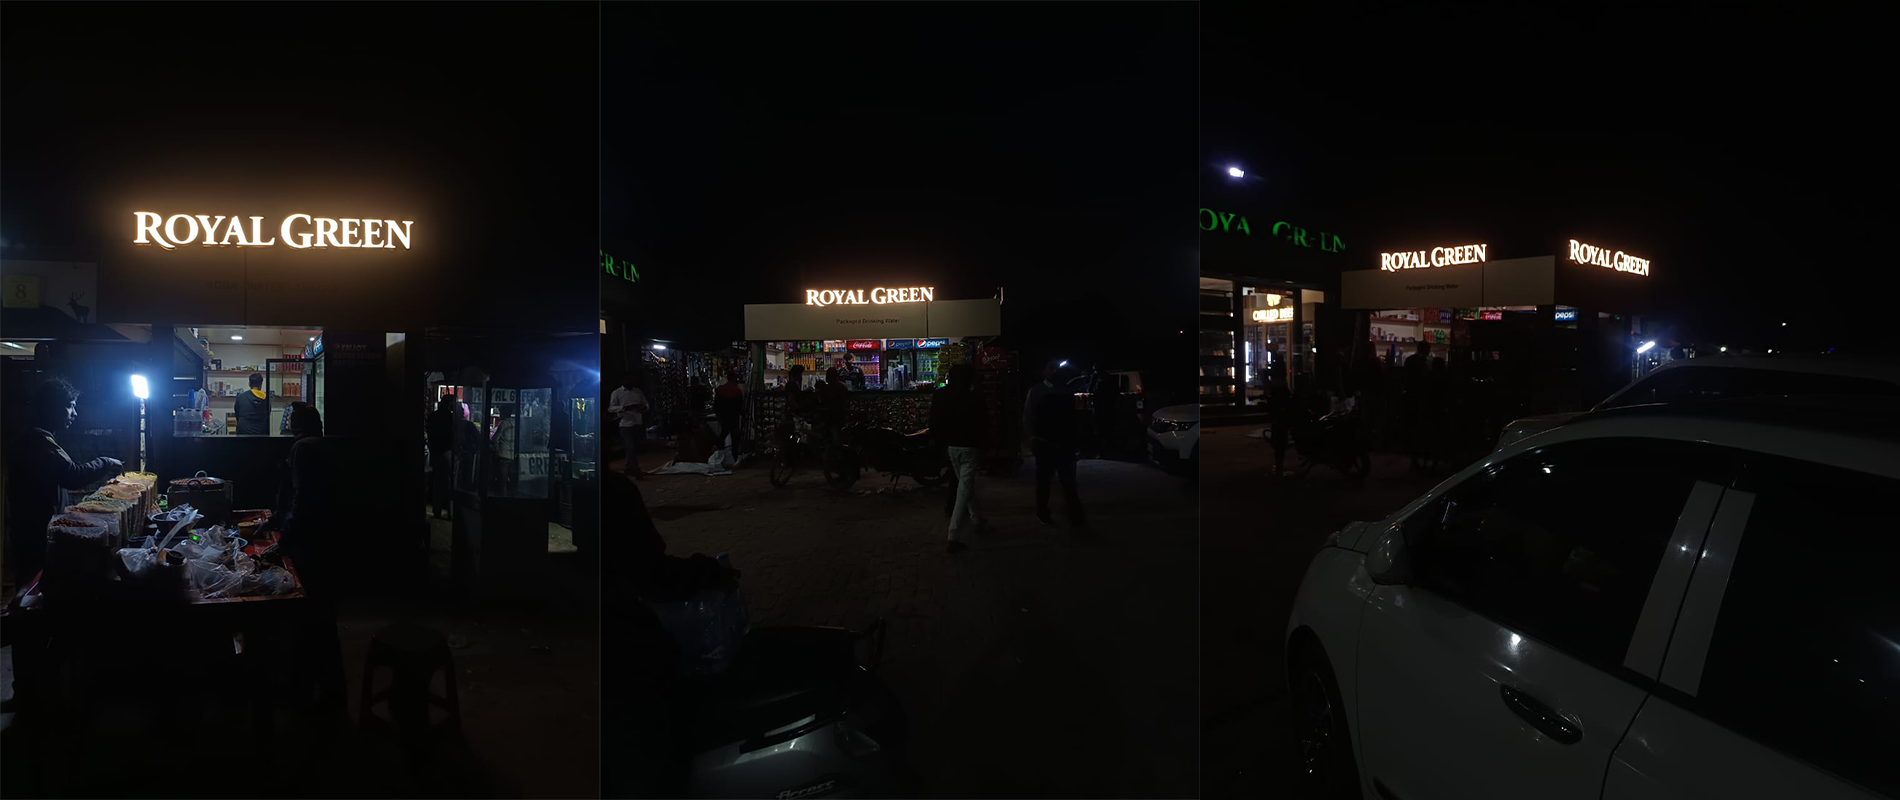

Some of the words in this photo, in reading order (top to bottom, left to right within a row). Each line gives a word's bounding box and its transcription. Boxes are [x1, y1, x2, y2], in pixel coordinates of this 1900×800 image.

[133, 211, 275, 249] ROYAL
[280, 213, 414, 249] GREEN
[1272, 221, 1346, 253] GREN
[1381, 250, 1430, 272] ROYAL
[1431, 244, 1487, 268] GREEN
[1569, 239, 1613, 269] ROYAL
[1613, 251, 1650, 277] GREEN
[15, 283, 26, 300] 8
[805, 289, 869, 307] ROYAL
[870, 287, 934, 304] GREEN
